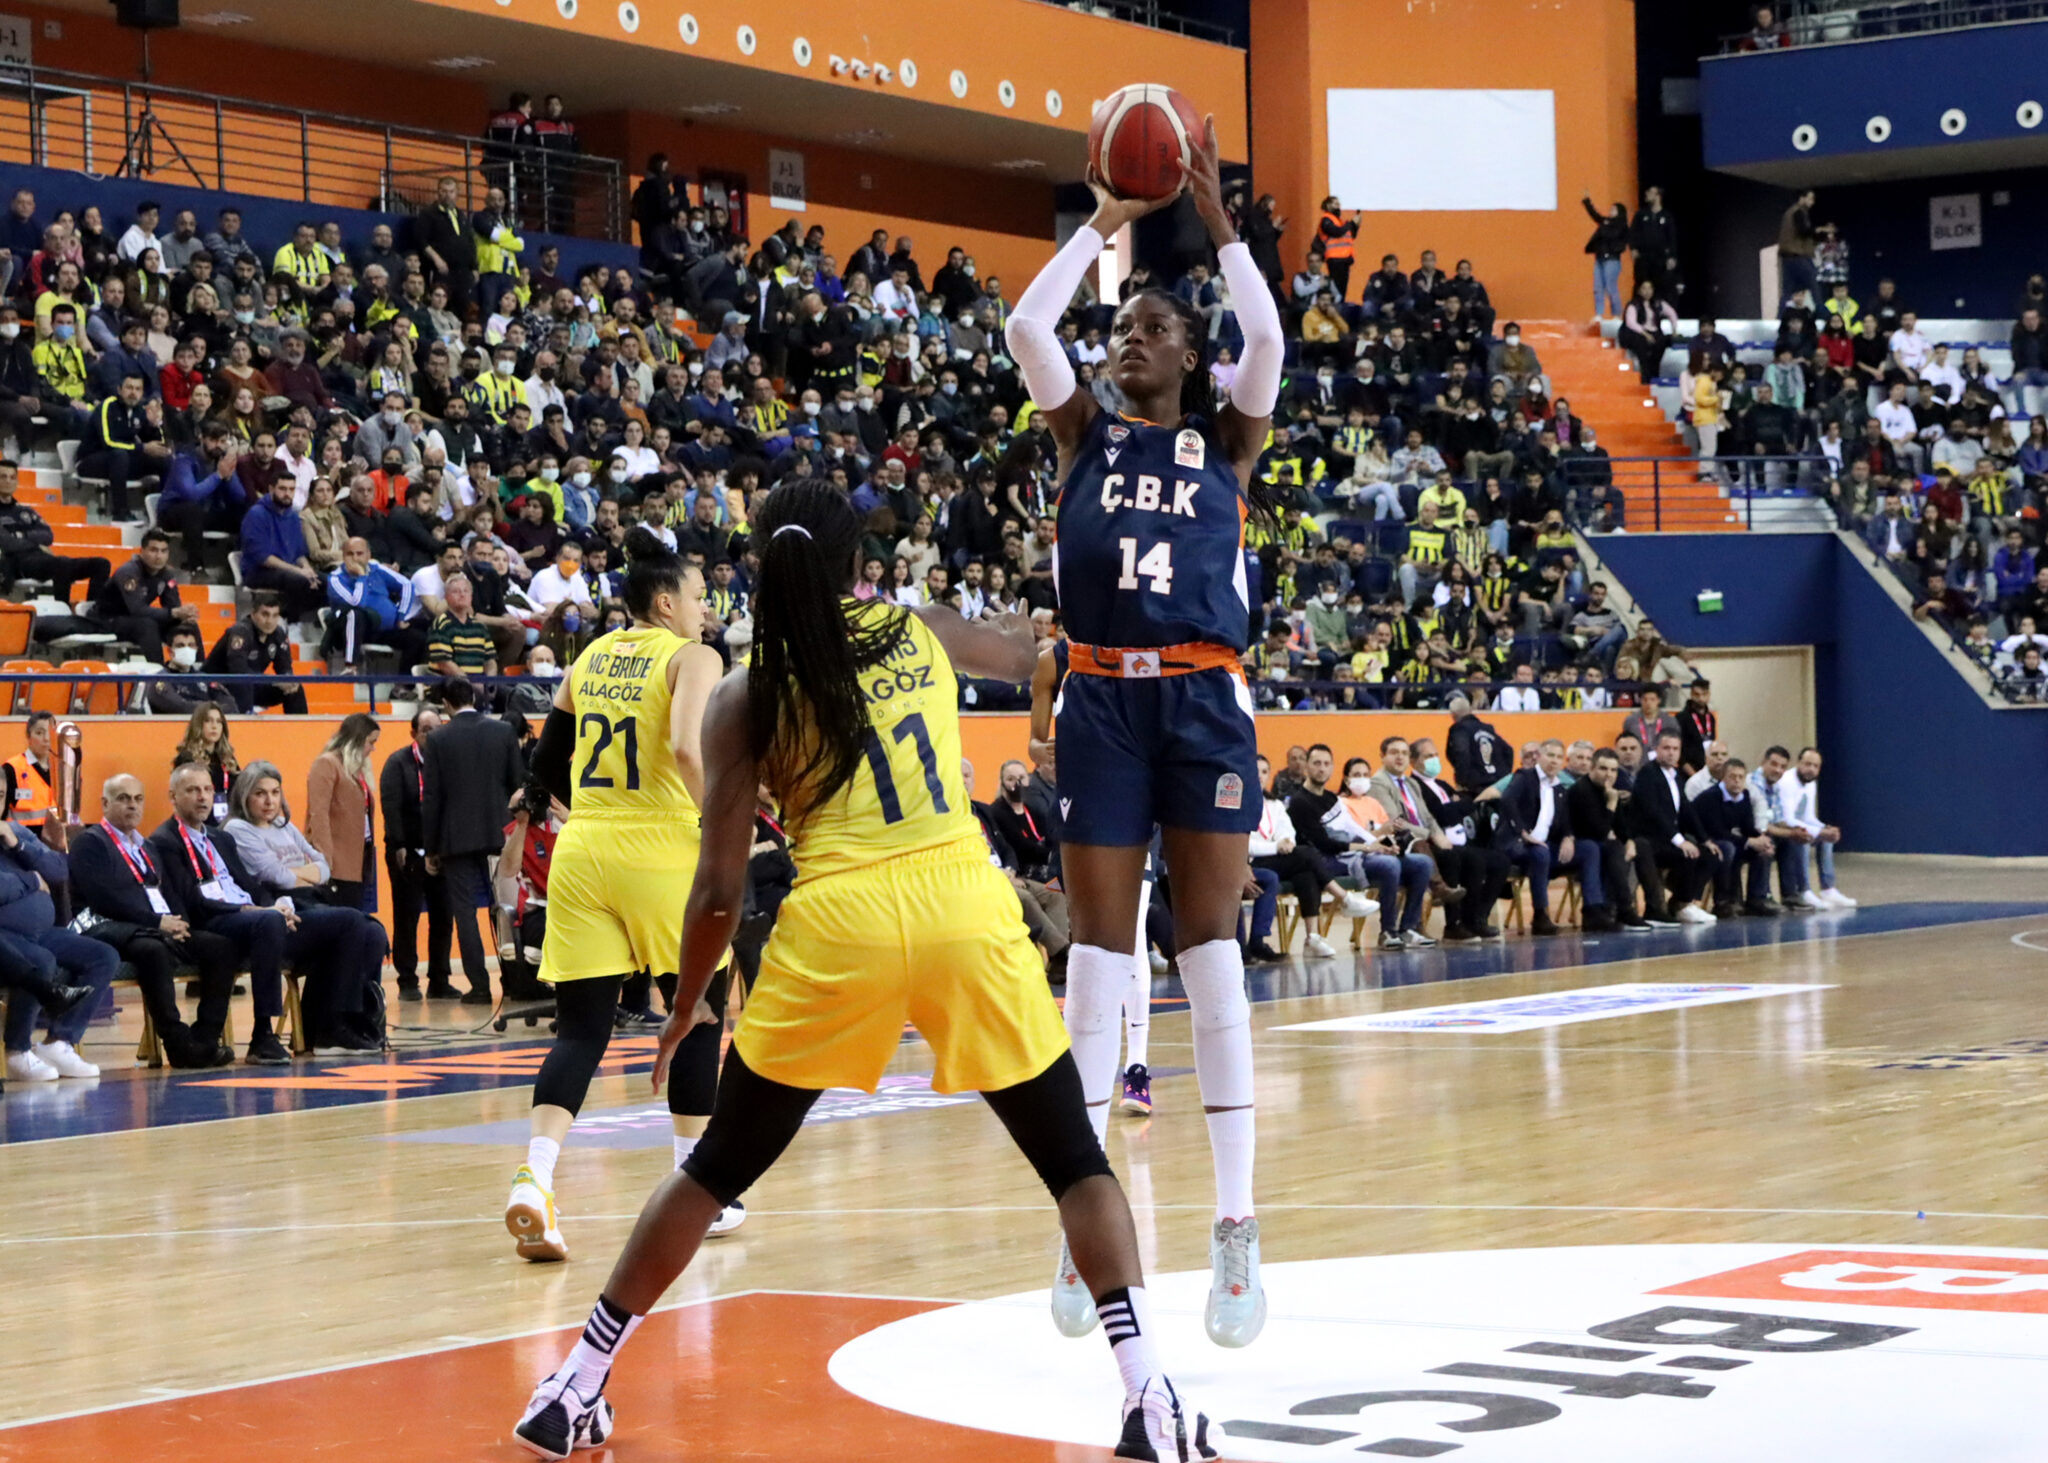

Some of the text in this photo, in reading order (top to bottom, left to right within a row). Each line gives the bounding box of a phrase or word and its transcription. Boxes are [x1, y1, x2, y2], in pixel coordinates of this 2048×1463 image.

[1118, 537, 1173, 595] 14
[578, 681, 643, 702] ALAGÖZ
[585, 653, 654, 679] MC BRIDE
[579, 713, 640, 791] 21
[865, 712, 950, 825] 11
